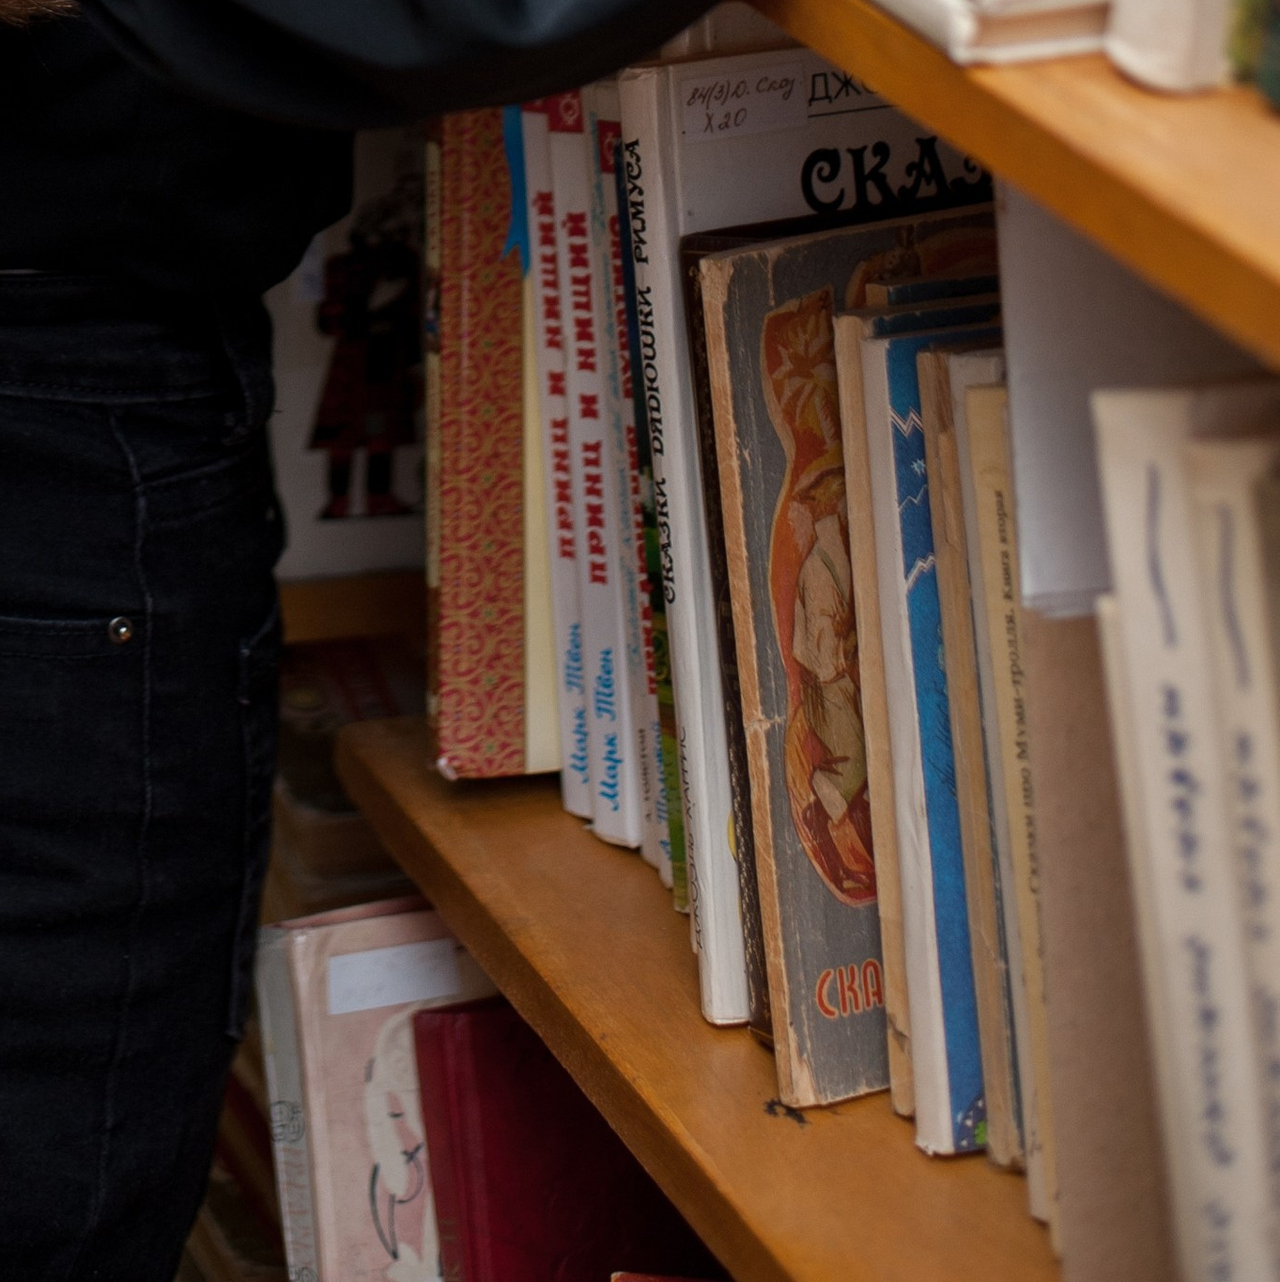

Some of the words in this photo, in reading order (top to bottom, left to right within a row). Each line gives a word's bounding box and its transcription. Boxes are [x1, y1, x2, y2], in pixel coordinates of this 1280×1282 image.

[807, 70, 878, 107] ДЖ
[625, 138, 650, 265] РИМУСА
[532, 190, 562, 349] НИЩИЙ
[562, 211, 598, 372] НИЩИЙ
[548, 370, 567, 397] И
[579, 393, 599, 420] И
[551, 418, 577, 559] ПРИНЦ
[582, 440, 609, 585] ПРИНЦ
[655, 476, 676, 605] СКАЗКИ
[593, 646, 615, 722] Твен
[569, 705, 590, 785] Марк
[598, 724, 623, 812] Марк
